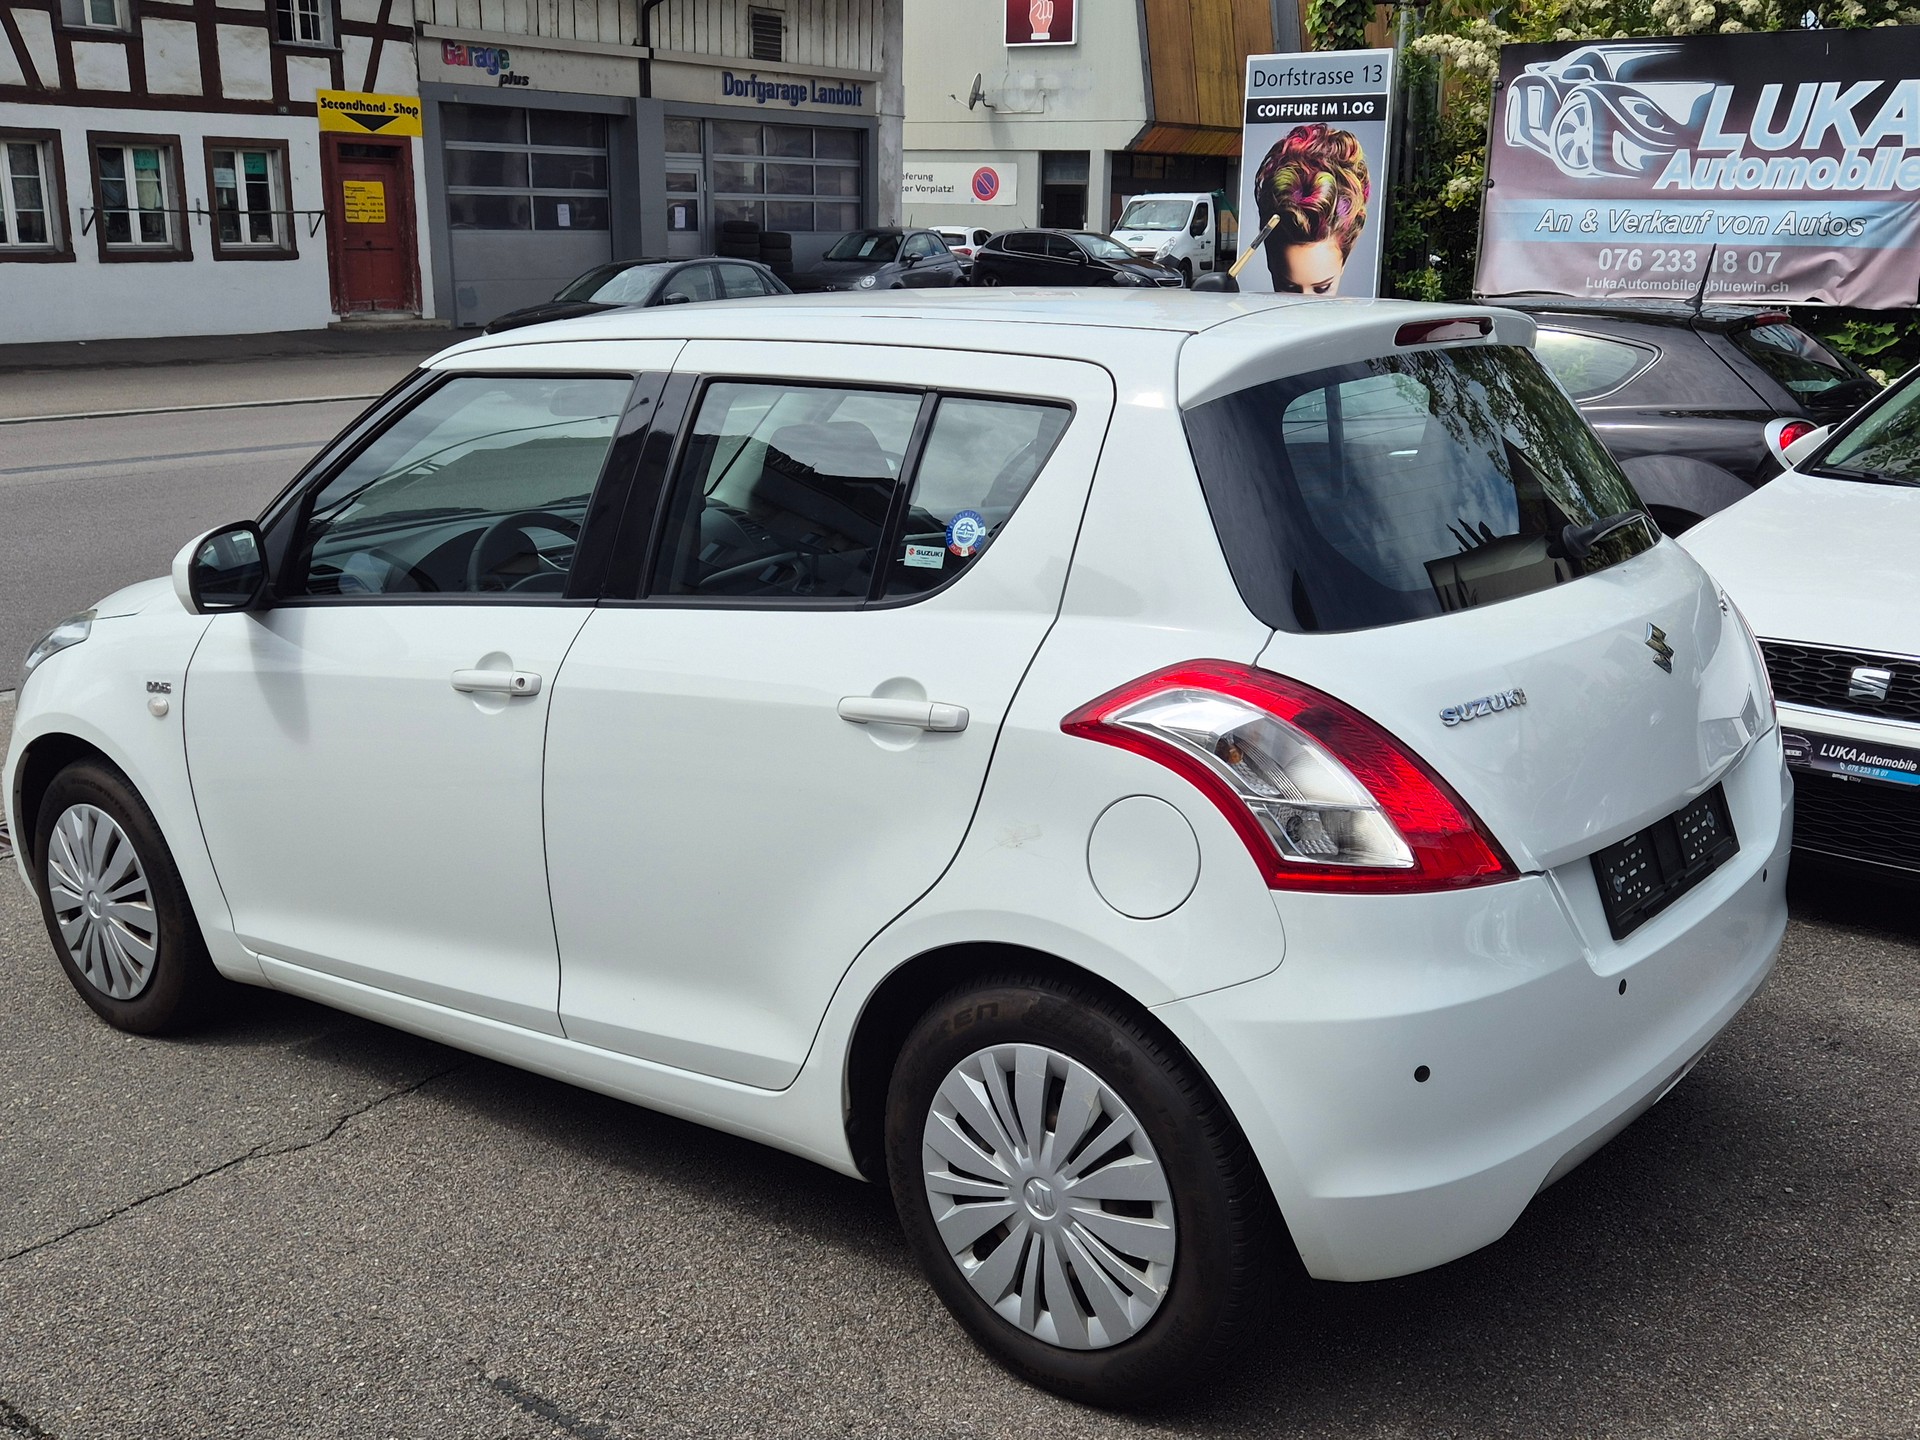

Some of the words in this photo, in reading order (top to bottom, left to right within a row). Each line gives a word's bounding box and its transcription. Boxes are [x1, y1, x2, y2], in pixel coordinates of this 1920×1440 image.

[441, 39, 510, 76] Garage
[498, 70, 530, 87] plus
[722, 71, 807, 107] Dorfgarage
[810, 80, 862, 107] Landolt
[1253, 67, 1354, 88] Dorfstrasse
[1362, 64, 1383, 83] 13
[320, 97, 386, 113] Secondhand
[393, 102, 419, 119] Shop
[1257, 103, 1319, 117] COIFFURE
[1321, 102, 1338, 115] IM
[1342, 101, 1375, 115] 1.OG
[1697, 79, 1920, 151] LUKA
[1652, 146, 1920, 191] Automobile
[915, 184, 955, 194] Vorplatz!
[1534, 209, 1574, 232] An
[1579, 209, 1598, 232] &
[1607, 209, 1713, 234] Verkauf
[1716, 217, 1770, 235] von
[1773, 211, 1867, 237] Autos
[1598, 248, 1643, 271] 076
[1650, 249, 1697, 273] 233
[1708, 250, 1738, 273] 18
[1747, 251, 1782, 274] 07
[916, 549, 943, 557] SUZUKI
[1439, 688, 1528, 727] SUZUKI
[1819, 743, 1857, 761] LUKA
[1857, 752, 1918, 772] Automobile
